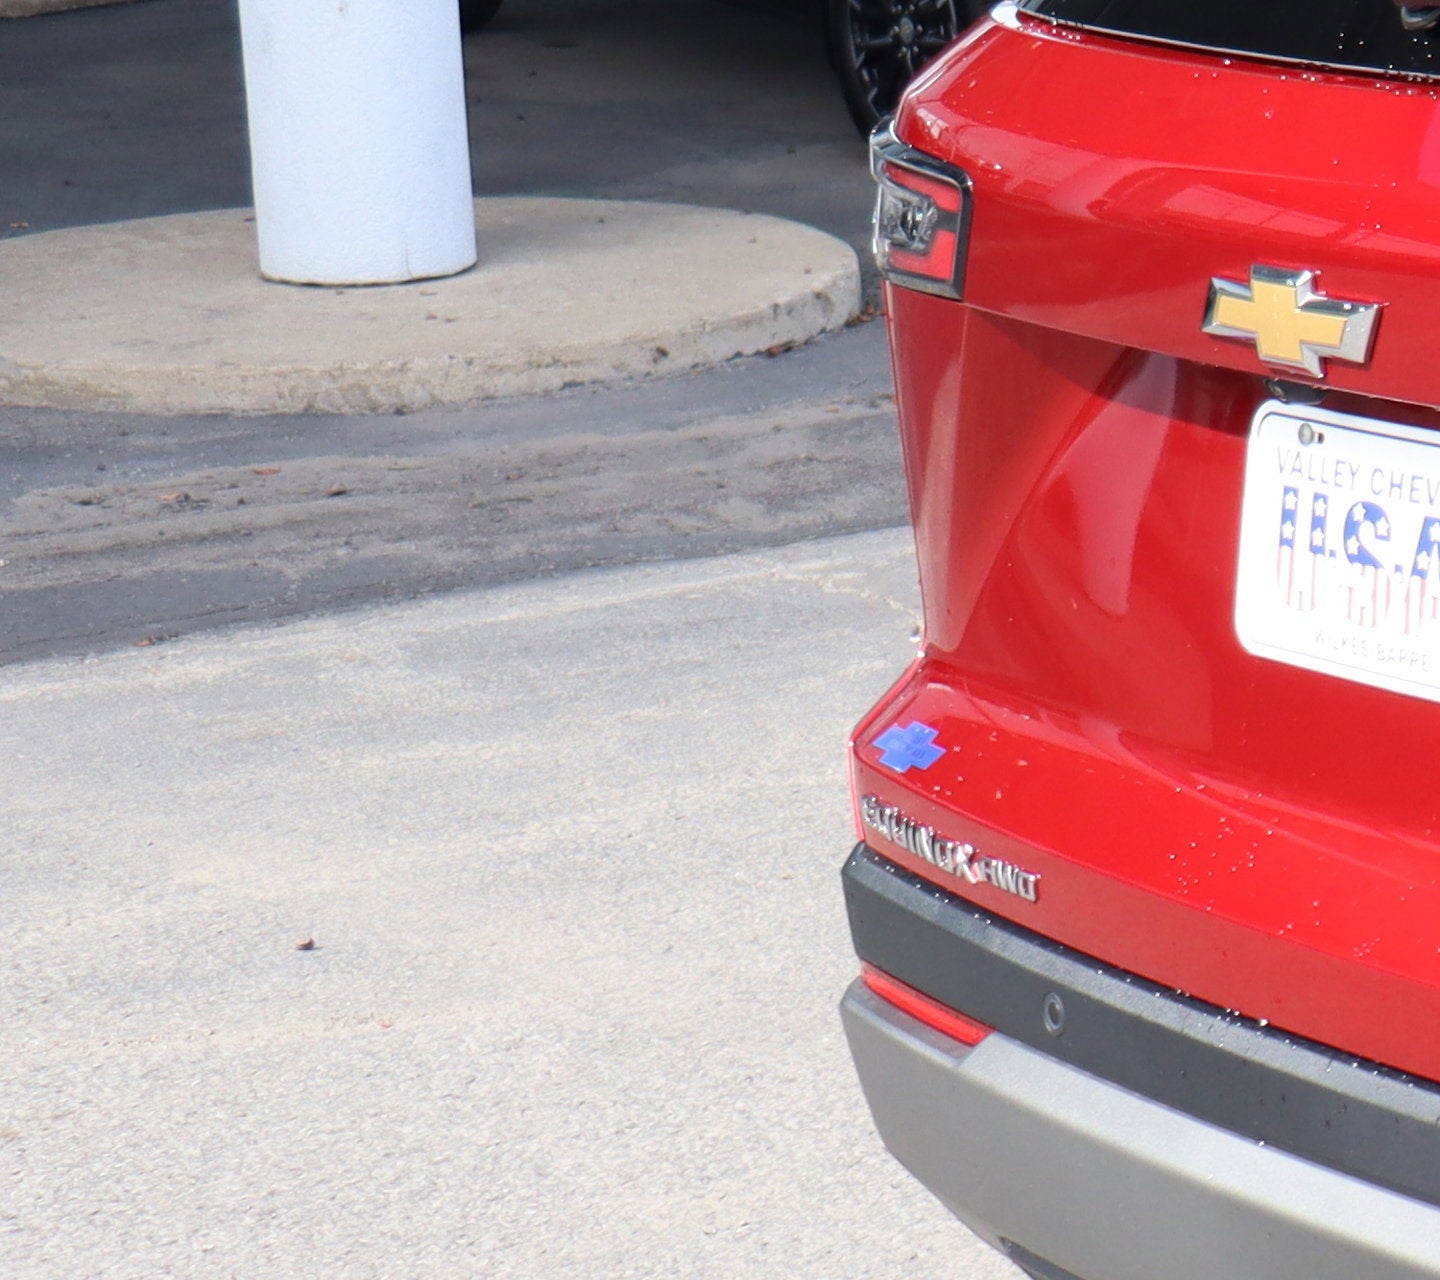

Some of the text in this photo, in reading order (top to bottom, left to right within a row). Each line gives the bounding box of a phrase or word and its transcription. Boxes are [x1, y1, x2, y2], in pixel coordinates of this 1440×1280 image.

[1276, 447, 1361, 491] VALLEY
[1314, 629, 1369, 658] WLKES
[861, 793, 1041, 903] EQUINOX AWD
